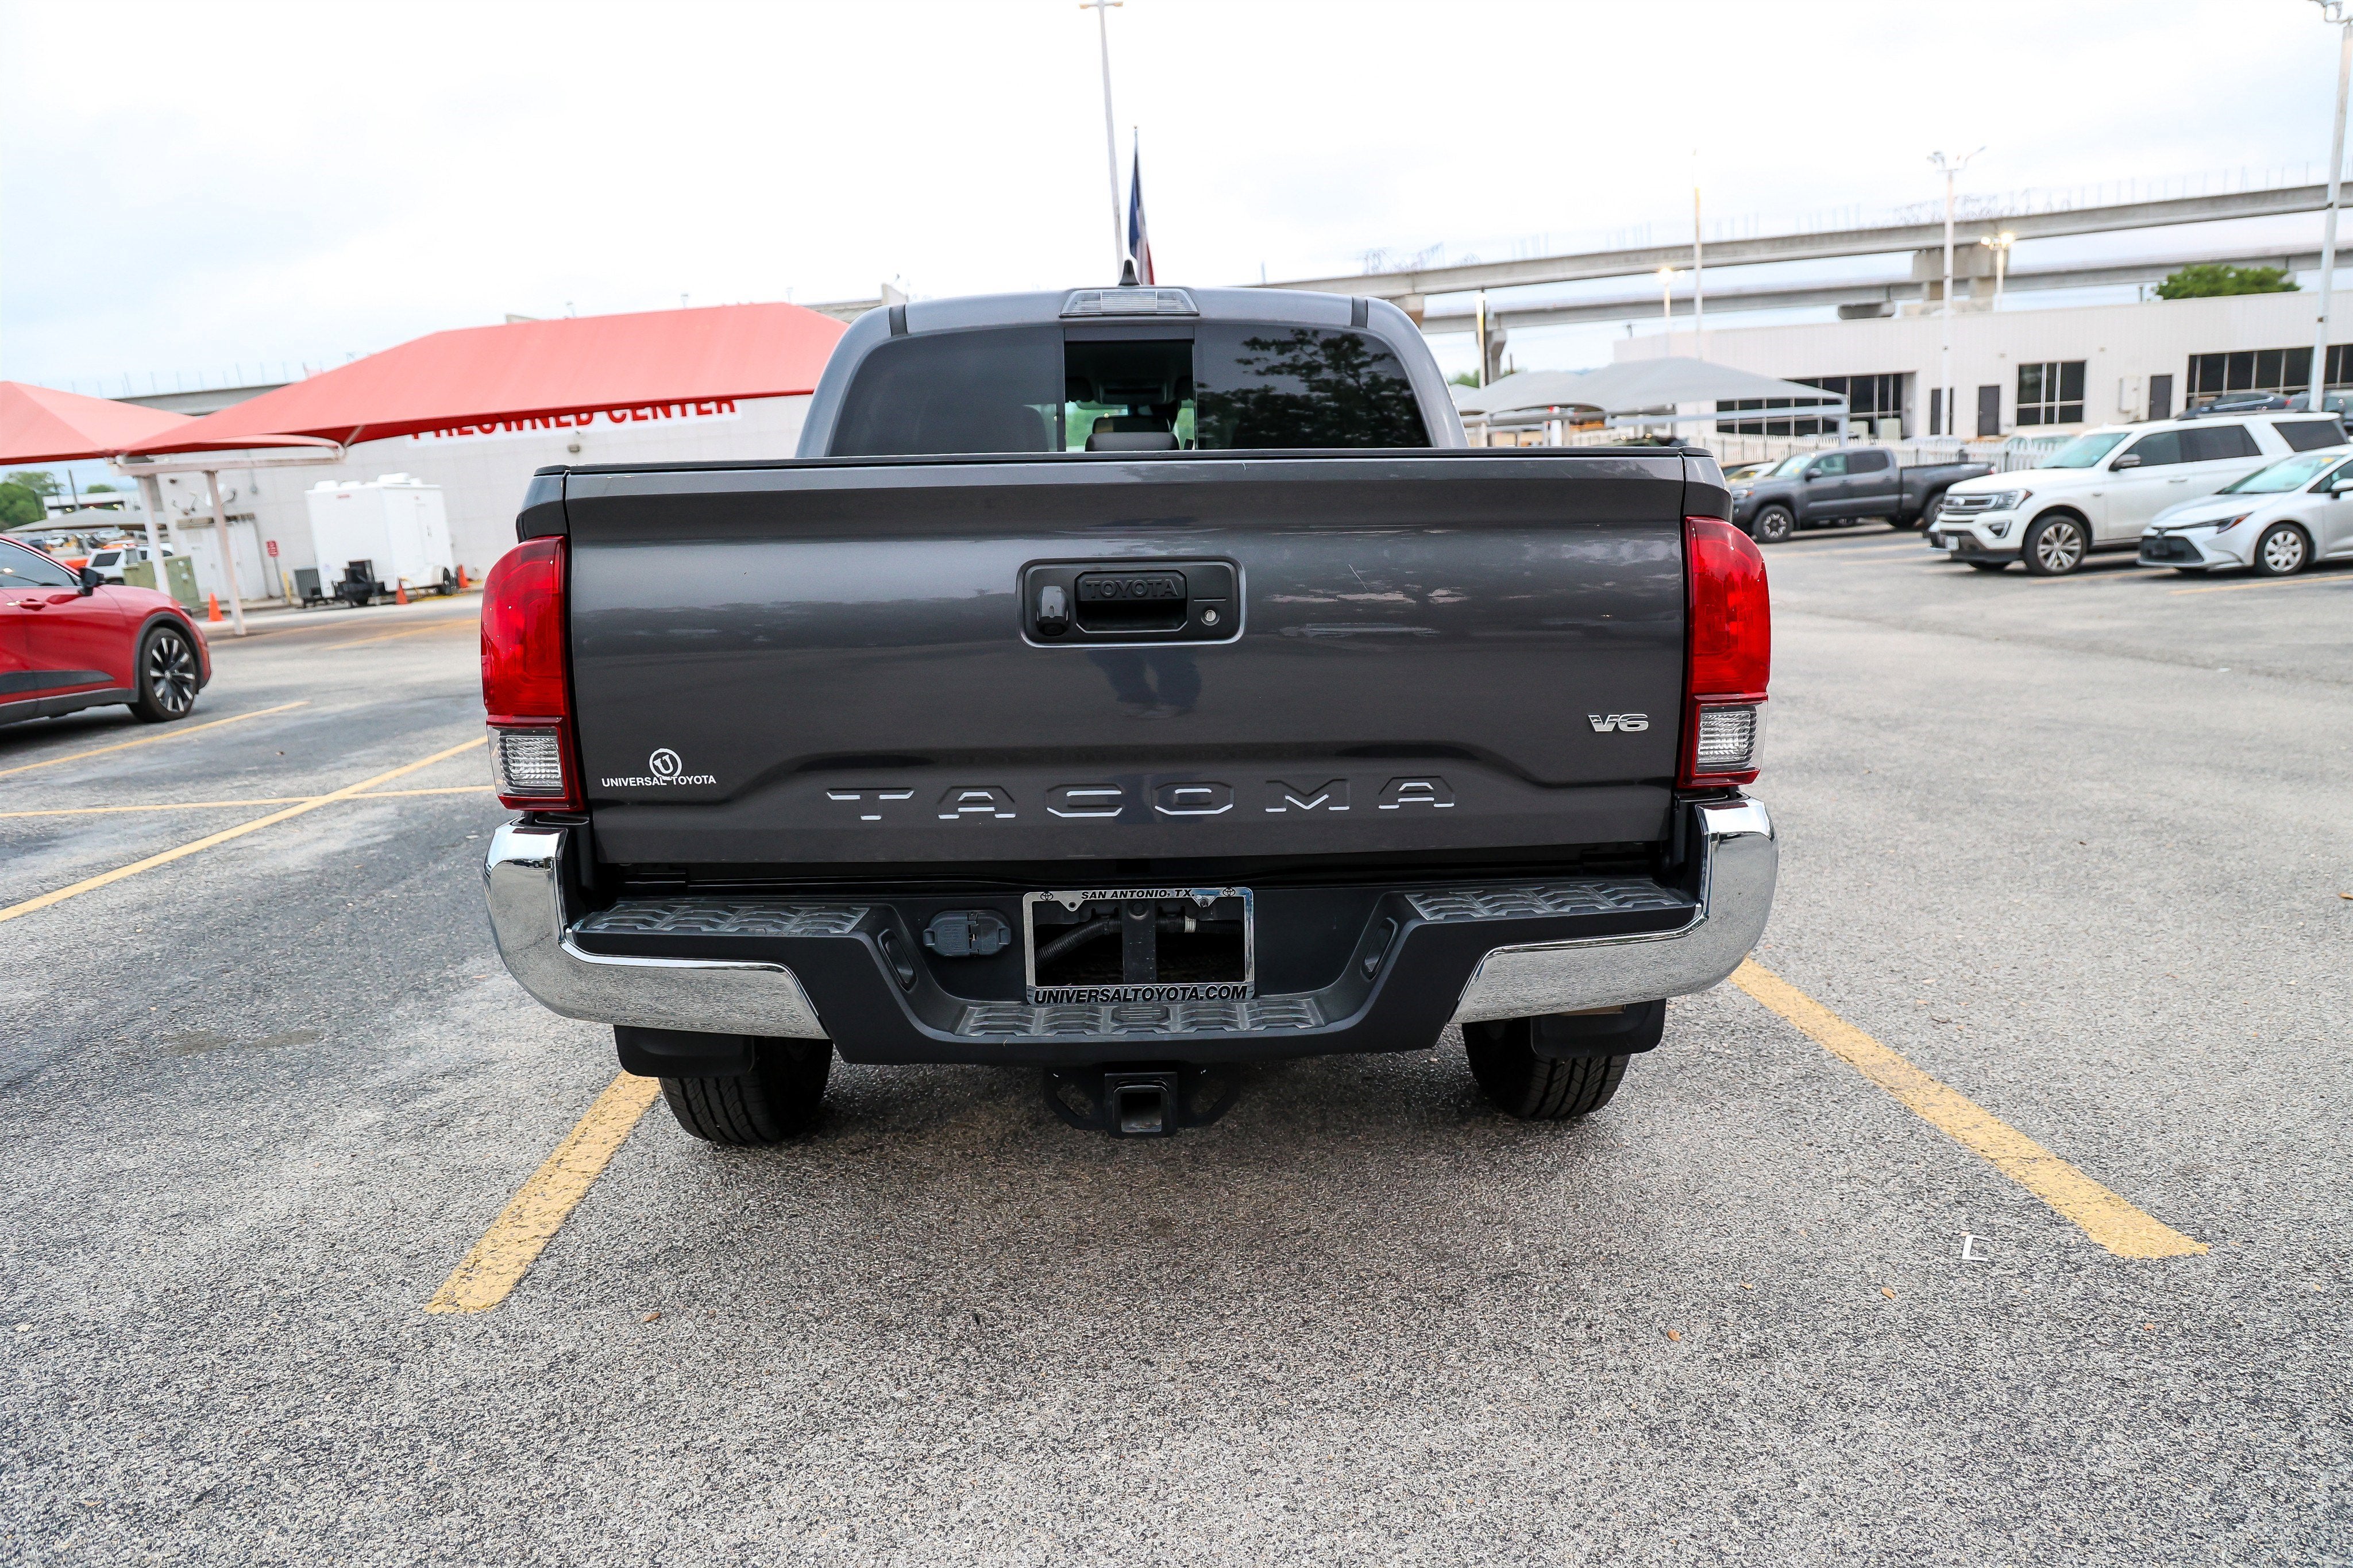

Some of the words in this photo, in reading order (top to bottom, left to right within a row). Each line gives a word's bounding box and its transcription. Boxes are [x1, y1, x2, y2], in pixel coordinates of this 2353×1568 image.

[1085, 578, 1178, 598] TOYOTA
[1588, 713, 1649, 732] V6
[601, 777, 667, 787] UNIVERSAL
[672, 775, 716, 785] TOYOTA
[826, 775, 1456, 820] TACOMA
[1081, 891, 1107, 899] SAN
[1109, 890, 1170, 899] ANTONIO,
[1034, 985, 1248, 1004] UNIVERSALTOYOTA.COM
